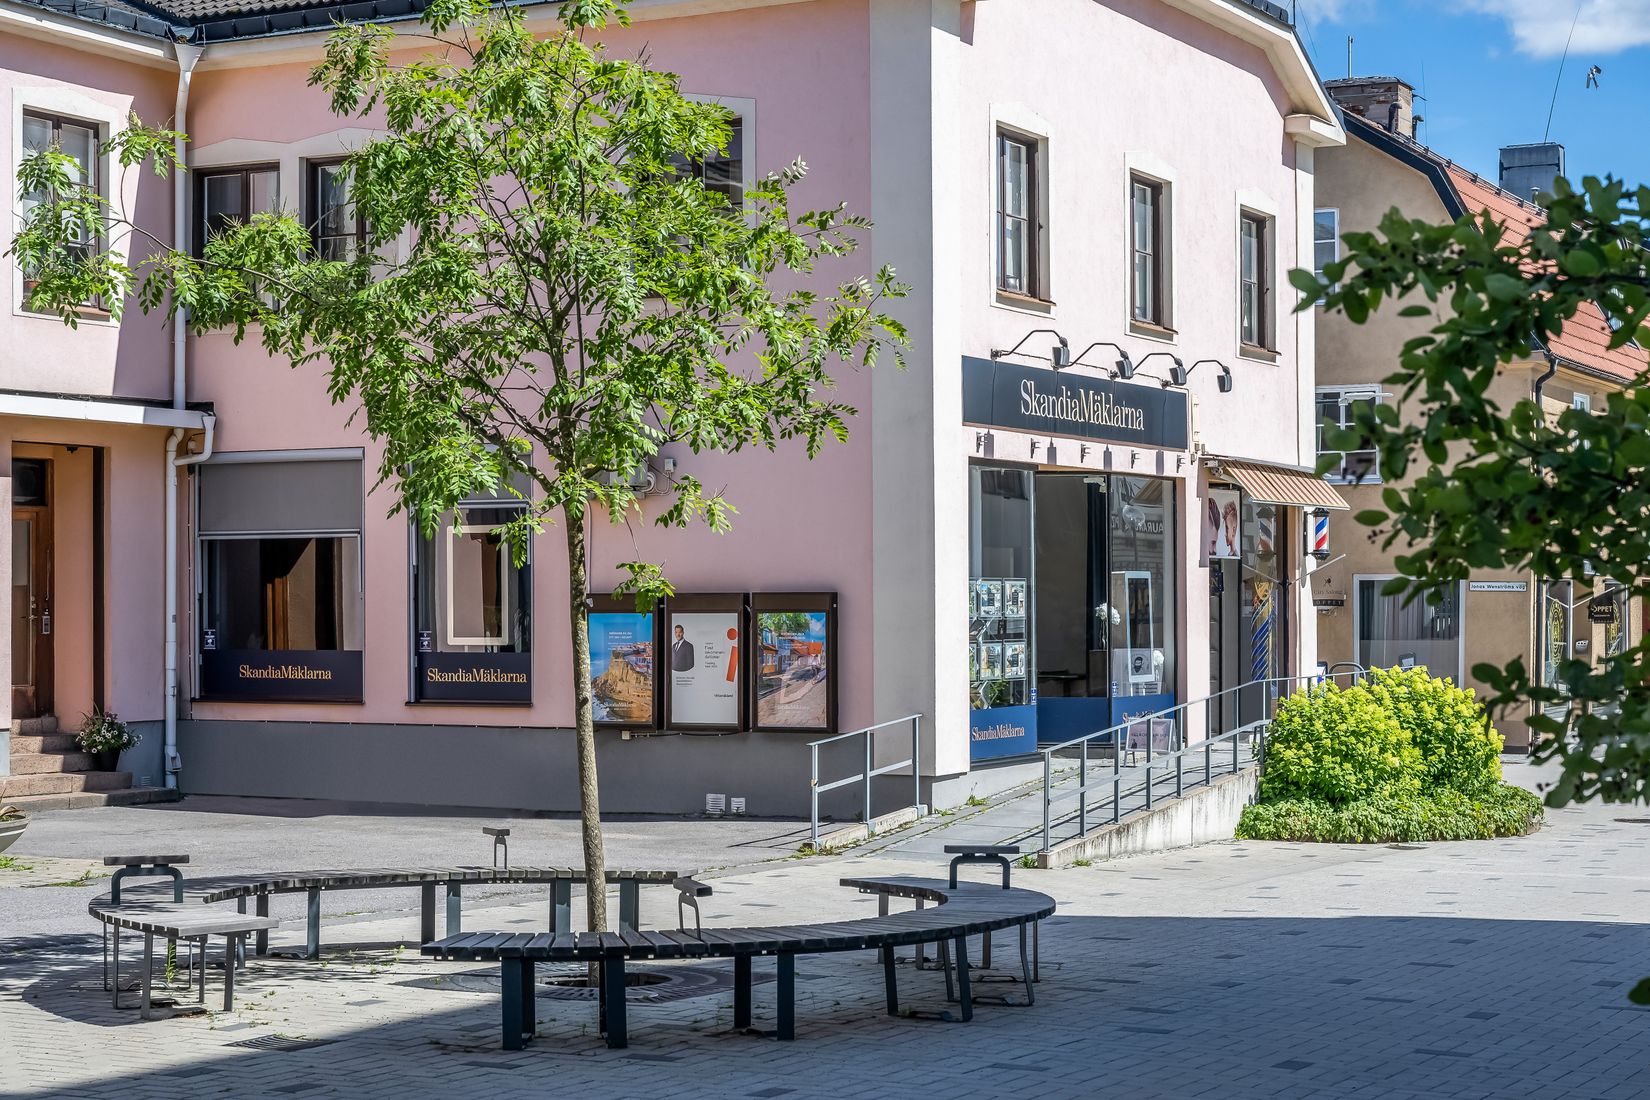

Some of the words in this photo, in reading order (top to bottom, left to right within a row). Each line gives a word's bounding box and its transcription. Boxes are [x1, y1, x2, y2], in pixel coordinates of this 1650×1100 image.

[1020, 379, 1145, 431] SkandiaMäklarna
[239, 664, 332, 680] SkandiaMäklarna
[427, 667, 527, 683] SkandiaMäklarna
[971, 724, 1025, 742] SkandiaMäklarna
